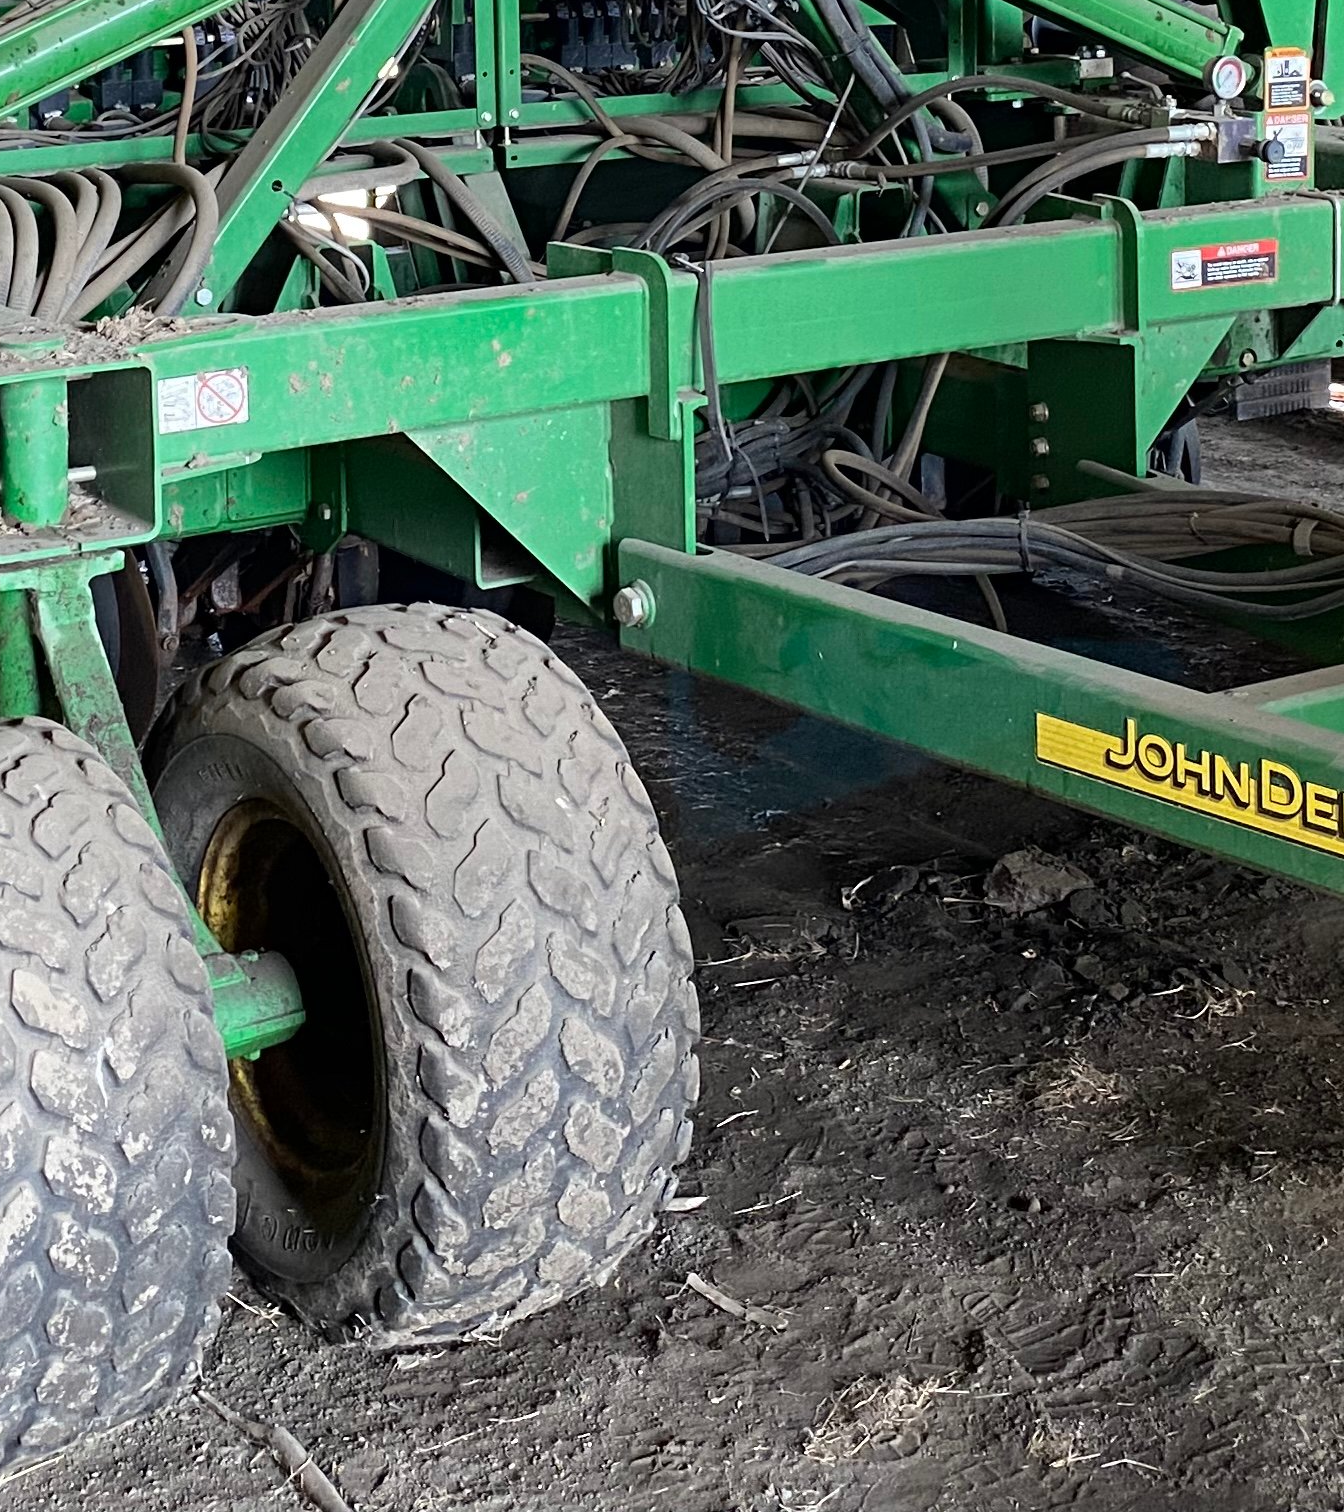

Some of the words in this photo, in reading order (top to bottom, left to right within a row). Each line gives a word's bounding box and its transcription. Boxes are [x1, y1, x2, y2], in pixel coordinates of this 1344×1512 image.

[1273, 114, 1309, 124] DANGER
[1226, 243, 1259, 256] DANGER
[1106, 717, 1251, 808] JOHN
